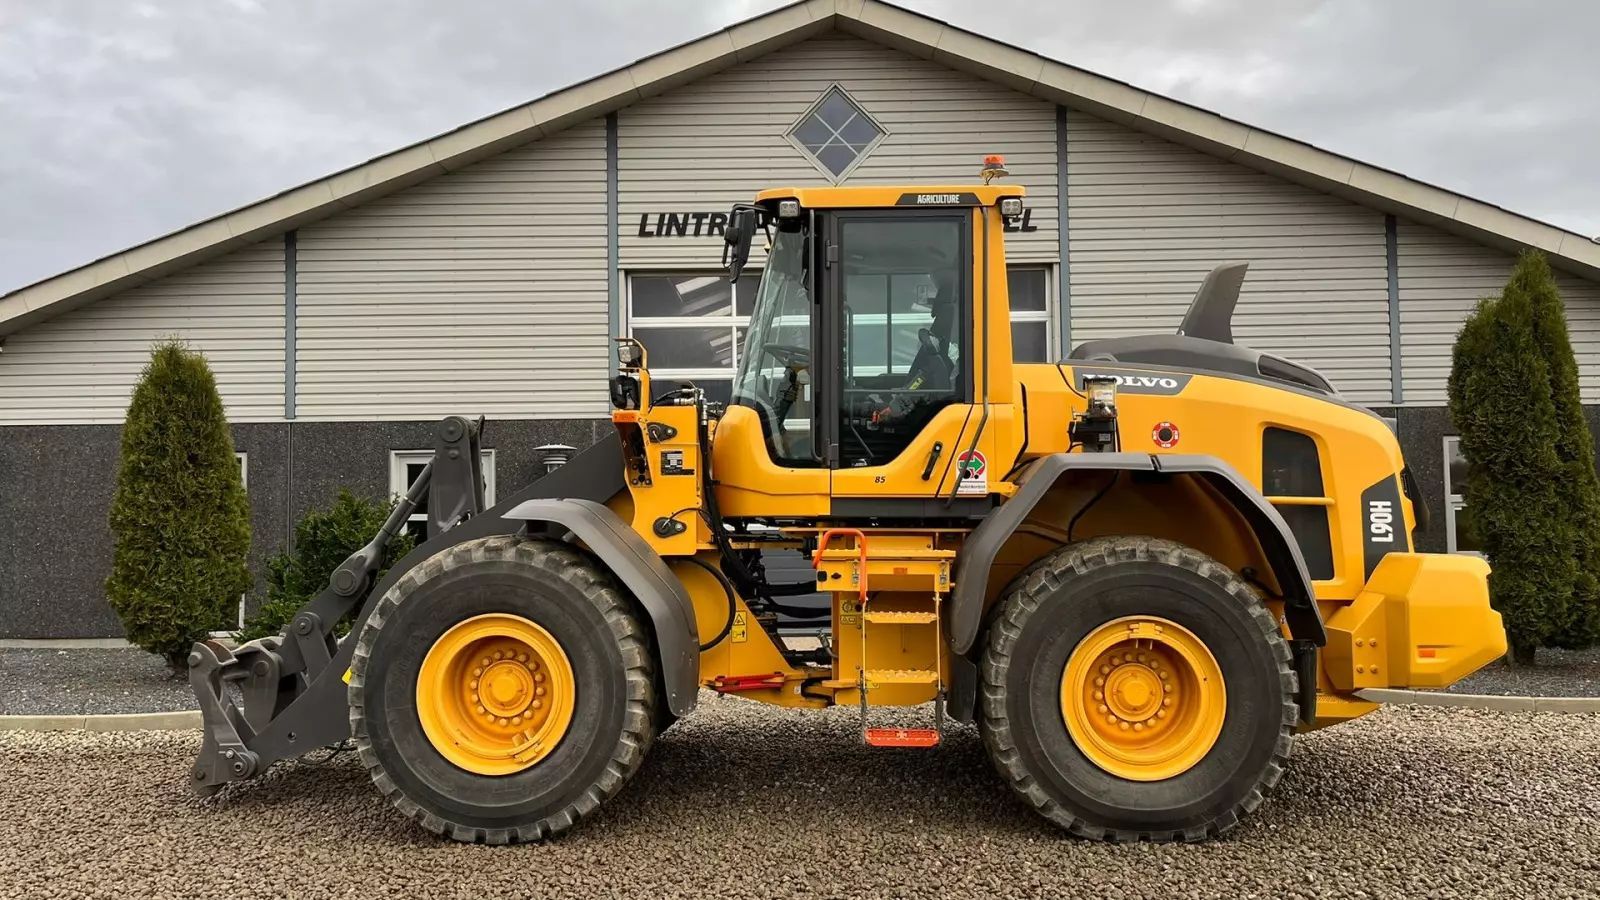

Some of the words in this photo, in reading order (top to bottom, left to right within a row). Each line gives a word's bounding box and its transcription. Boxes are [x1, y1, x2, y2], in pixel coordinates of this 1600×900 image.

[917, 194, 960, 204] AGRICULTURE
[638, 212, 755, 237] LINTR
[875, 475, 886, 484] 85
[1369, 501, 1393, 542] L90H
